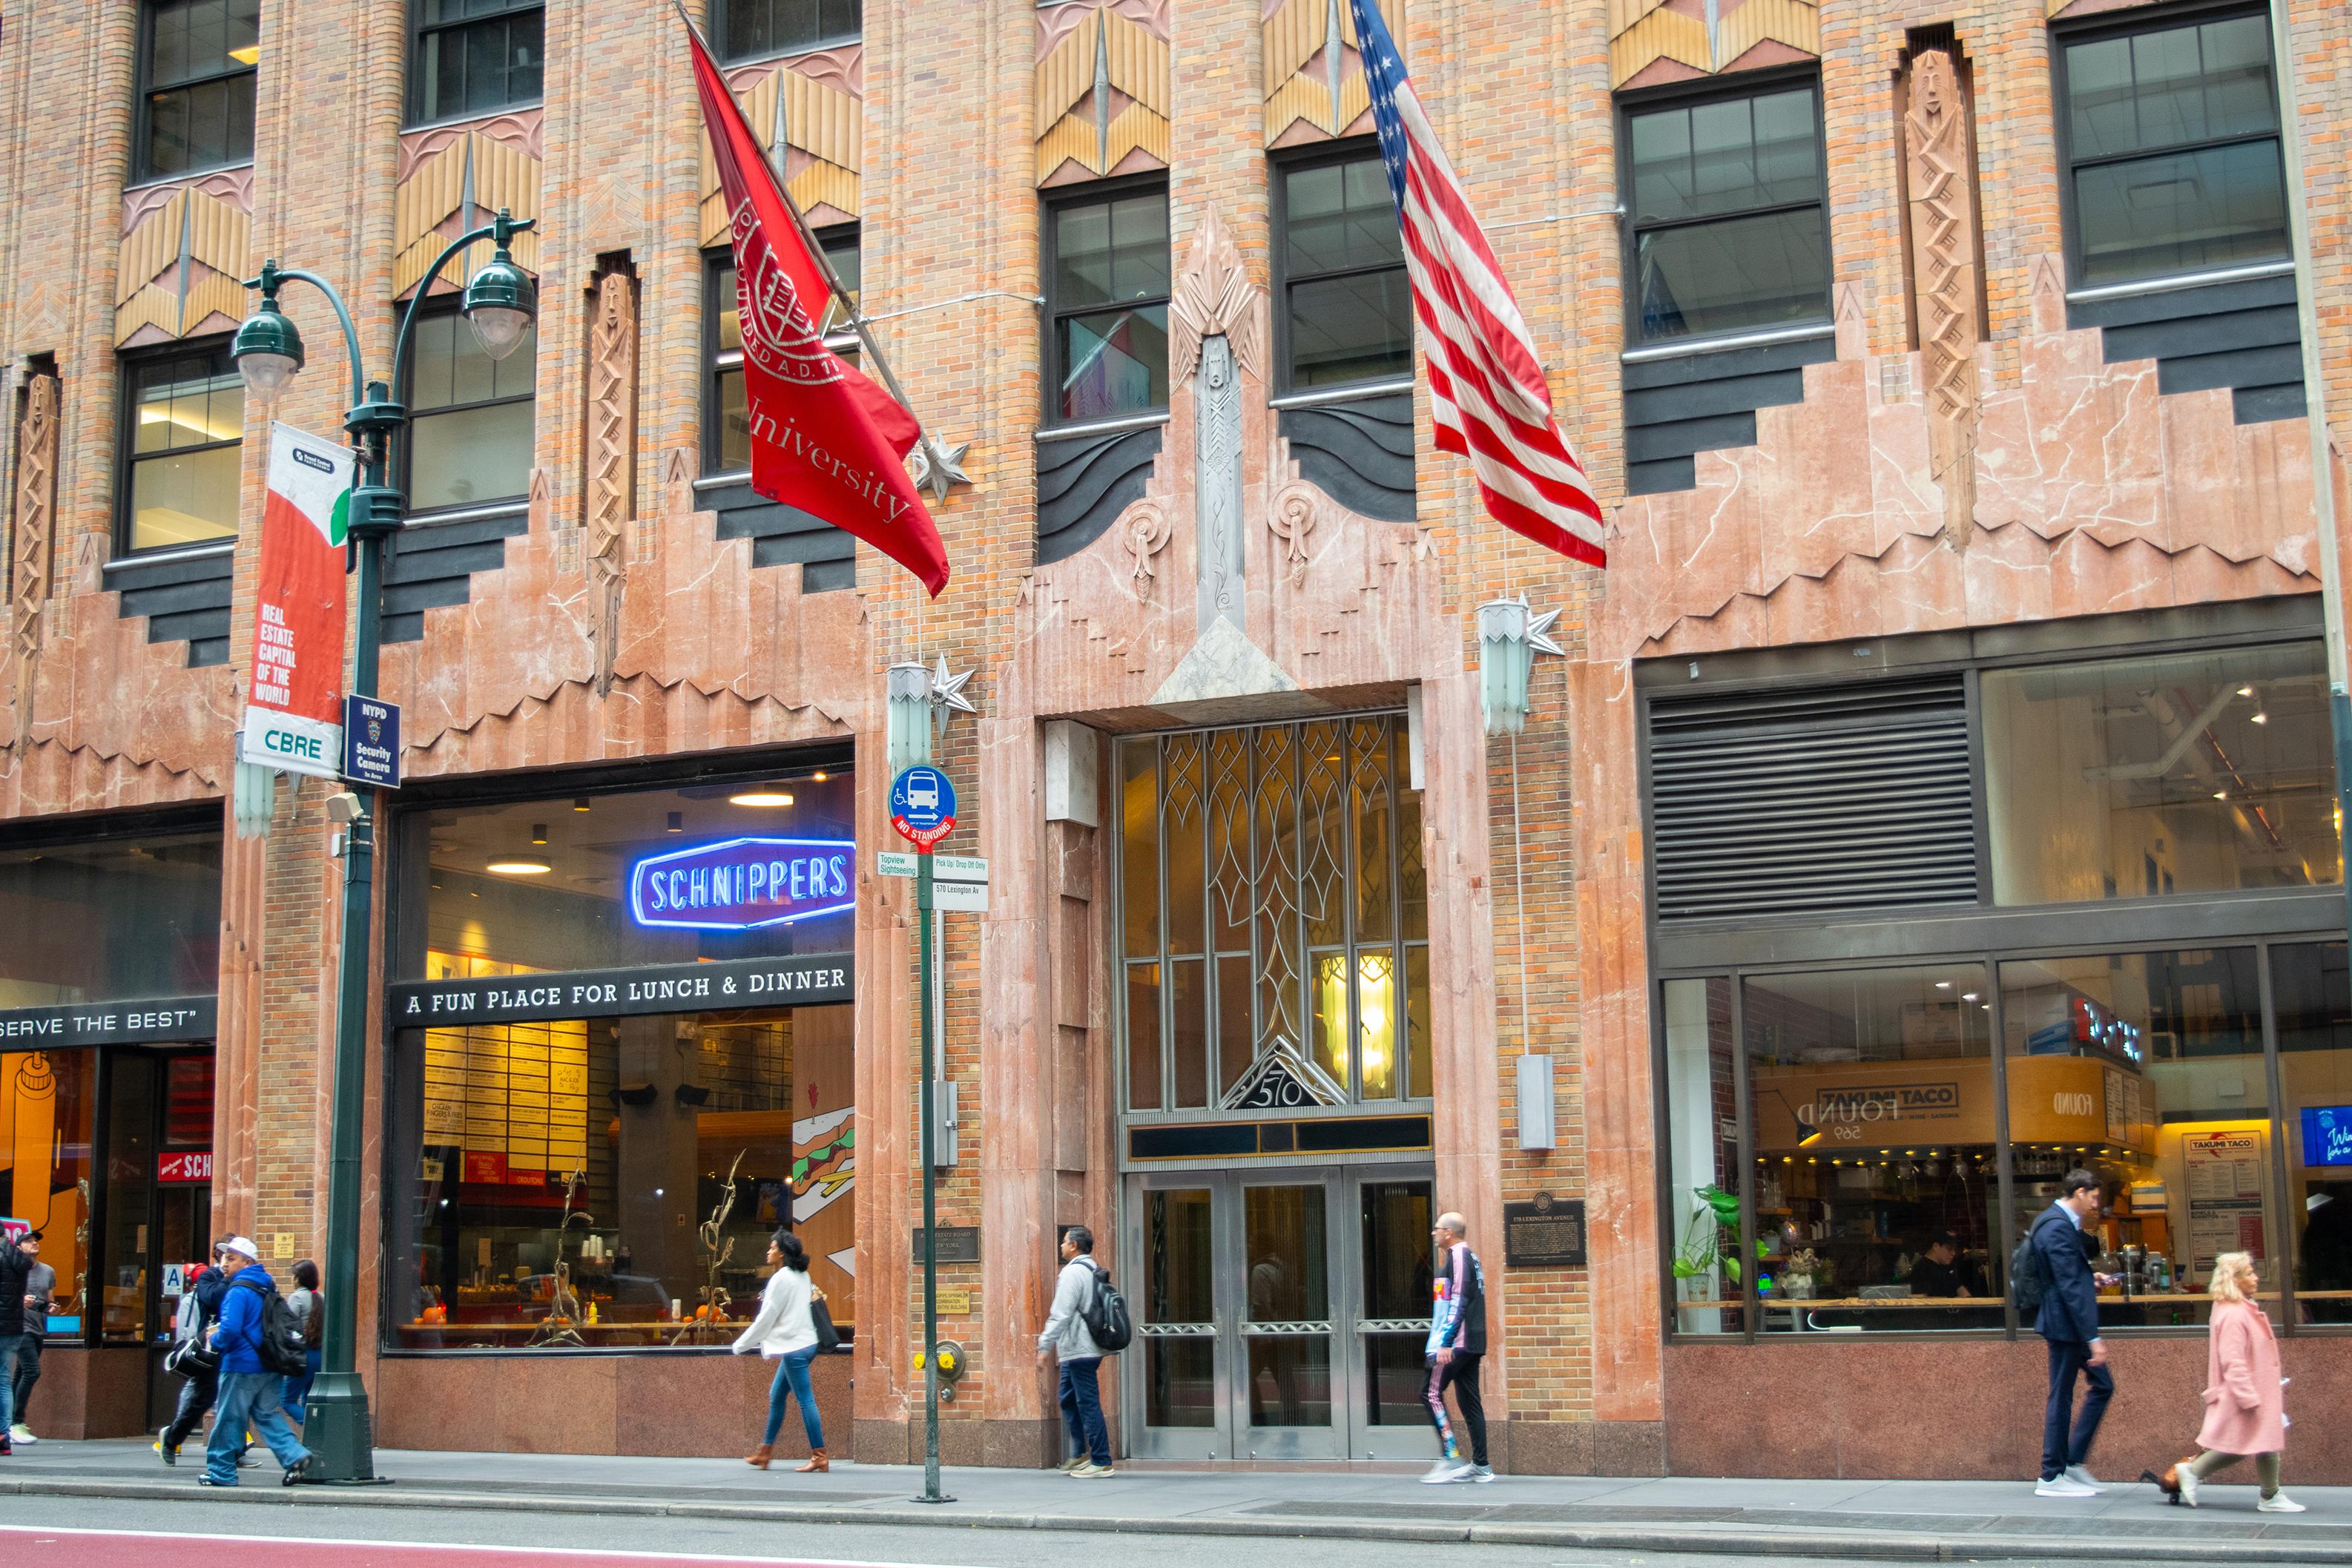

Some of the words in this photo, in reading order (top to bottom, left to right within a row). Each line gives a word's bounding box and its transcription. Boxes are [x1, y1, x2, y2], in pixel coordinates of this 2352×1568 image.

[262, 604, 285, 625] REAL
[260, 624, 294, 648] ESTATE
[259, 644, 297, 668] CAPITAL
[257, 663, 270, 682] OF
[272, 666, 291, 686] THE
[255, 682, 290, 706] WORLD
[362, 703, 387, 719] NYPD
[265, 729, 322, 760] CBRE
[356, 742, 391, 762] Security
[357, 756, 390, 773] Camera
[897, 820, 909, 833] NO
[911, 821, 952, 840] STANDING
[880, 854, 905, 864] Topview
[956, 860, 966, 869] Drop
[975, 861, 985, 871] Only
[880, 864, 916, 876] Sightseeing
[651, 854, 849, 912] SCHNIPPERS
[948, 885, 971, 895] Lexington
[406, 996, 421, 1013] A
[432, 992, 476, 1012] FUN
[487, 987, 561, 1009] PLACE
[572, 984, 617, 1004] FOR
[629, 978, 710, 1001] LUNCH
[722, 976, 737, 994] &
[749, 969, 846, 992] DINNER
[73, 1015, 116, 1032] THE
[1247, 1070, 1302, 1106] 570
[1900, 1088, 1952, 1104] TACO
[2328, 1145, 2342, 1161] for
[184, 1155, 211, 1177] SCH
[168, 1269, 179, 1285] A
